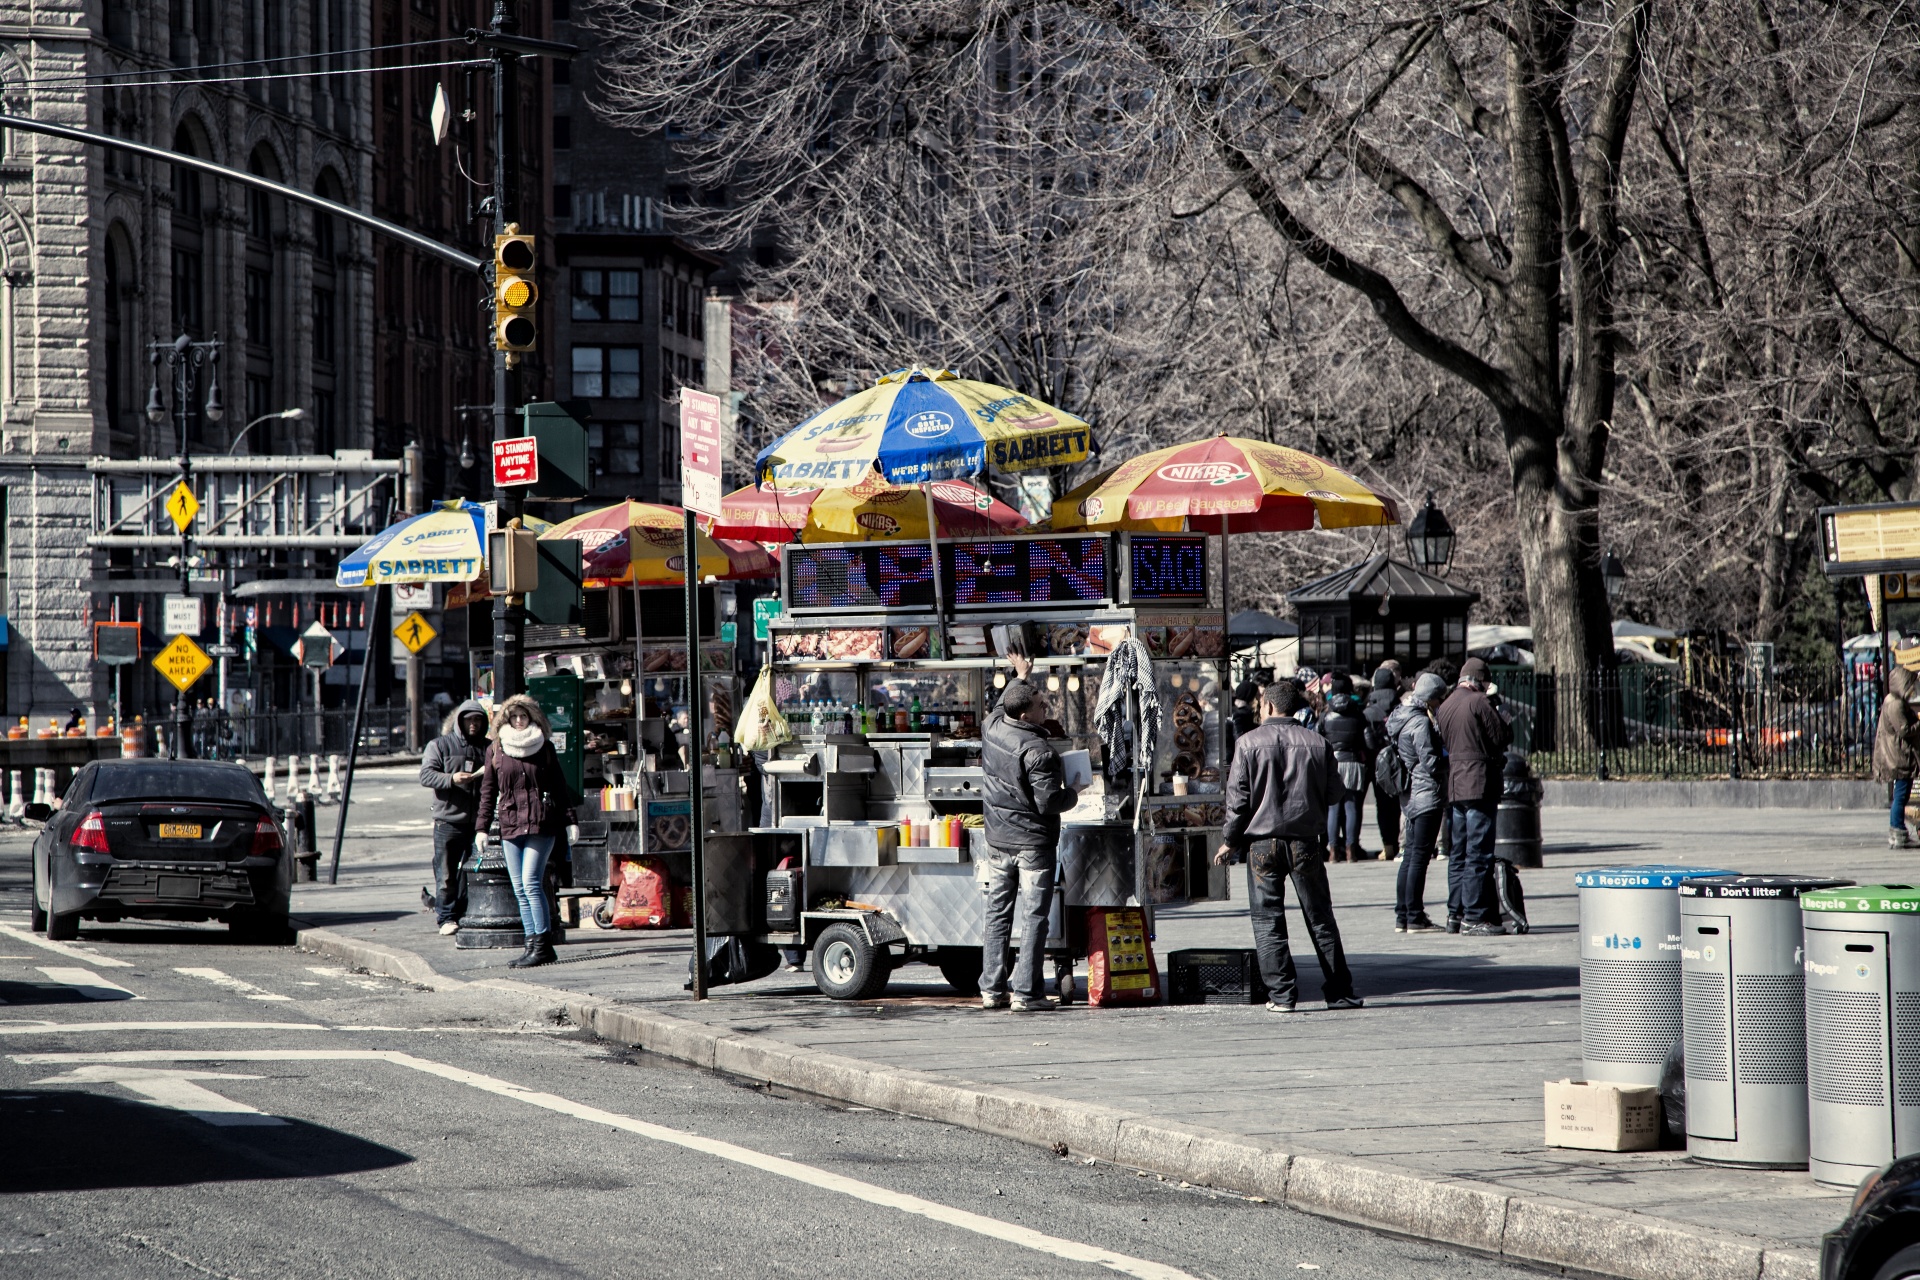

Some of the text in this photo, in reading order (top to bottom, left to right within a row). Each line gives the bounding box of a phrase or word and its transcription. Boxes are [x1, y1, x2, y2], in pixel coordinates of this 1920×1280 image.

[683, 396, 717, 416] NO STANDING
[976, 396, 1026, 424] SABRETT
[687, 416, 714, 433] ANY TIME
[803, 413, 884, 441] SABRETT
[495, 441, 534, 456] NO STANDING
[993, 430, 1087, 465] SABRETT
[500, 453, 531, 468] ANYTIME
[891, 464, 919, 477] WE'RE
[921, 462, 933, 472] ON
[935, 461, 942, 470] A
[944, 458, 965, 469] ROLL
[1170, 465, 1233, 481] NIKAS
[931, 485, 975, 503] NIKAS
[1136, 498, 1255, 513] All Beef Sausages
[722, 508, 803, 524] All Beef Sausages
[860, 514, 893, 530] NIKAS
[401, 528, 469, 546] SABRETT
[378, 558, 476, 576] SABRETT
[797, 537, 1105, 608] OPEN
[1167, 616, 1191, 625] HALAL
[1203, 615, 1223, 625] FOOD
[176, 645, 189, 653] NO
[169, 656, 195, 664] MERGE
[169, 667, 197, 675] AHEAD
[653, 804, 688, 813] PRETZEL
[1153, 835, 1176, 844] PRETZEL
[1599, 876, 1650, 887] Recycle
[1720, 887, 1782, 897] Don't litter
[1805, 897, 1847, 910] Recycle
[1880, 899, 1920, 911] Recy
[1809, 960, 1840, 976] Paper
